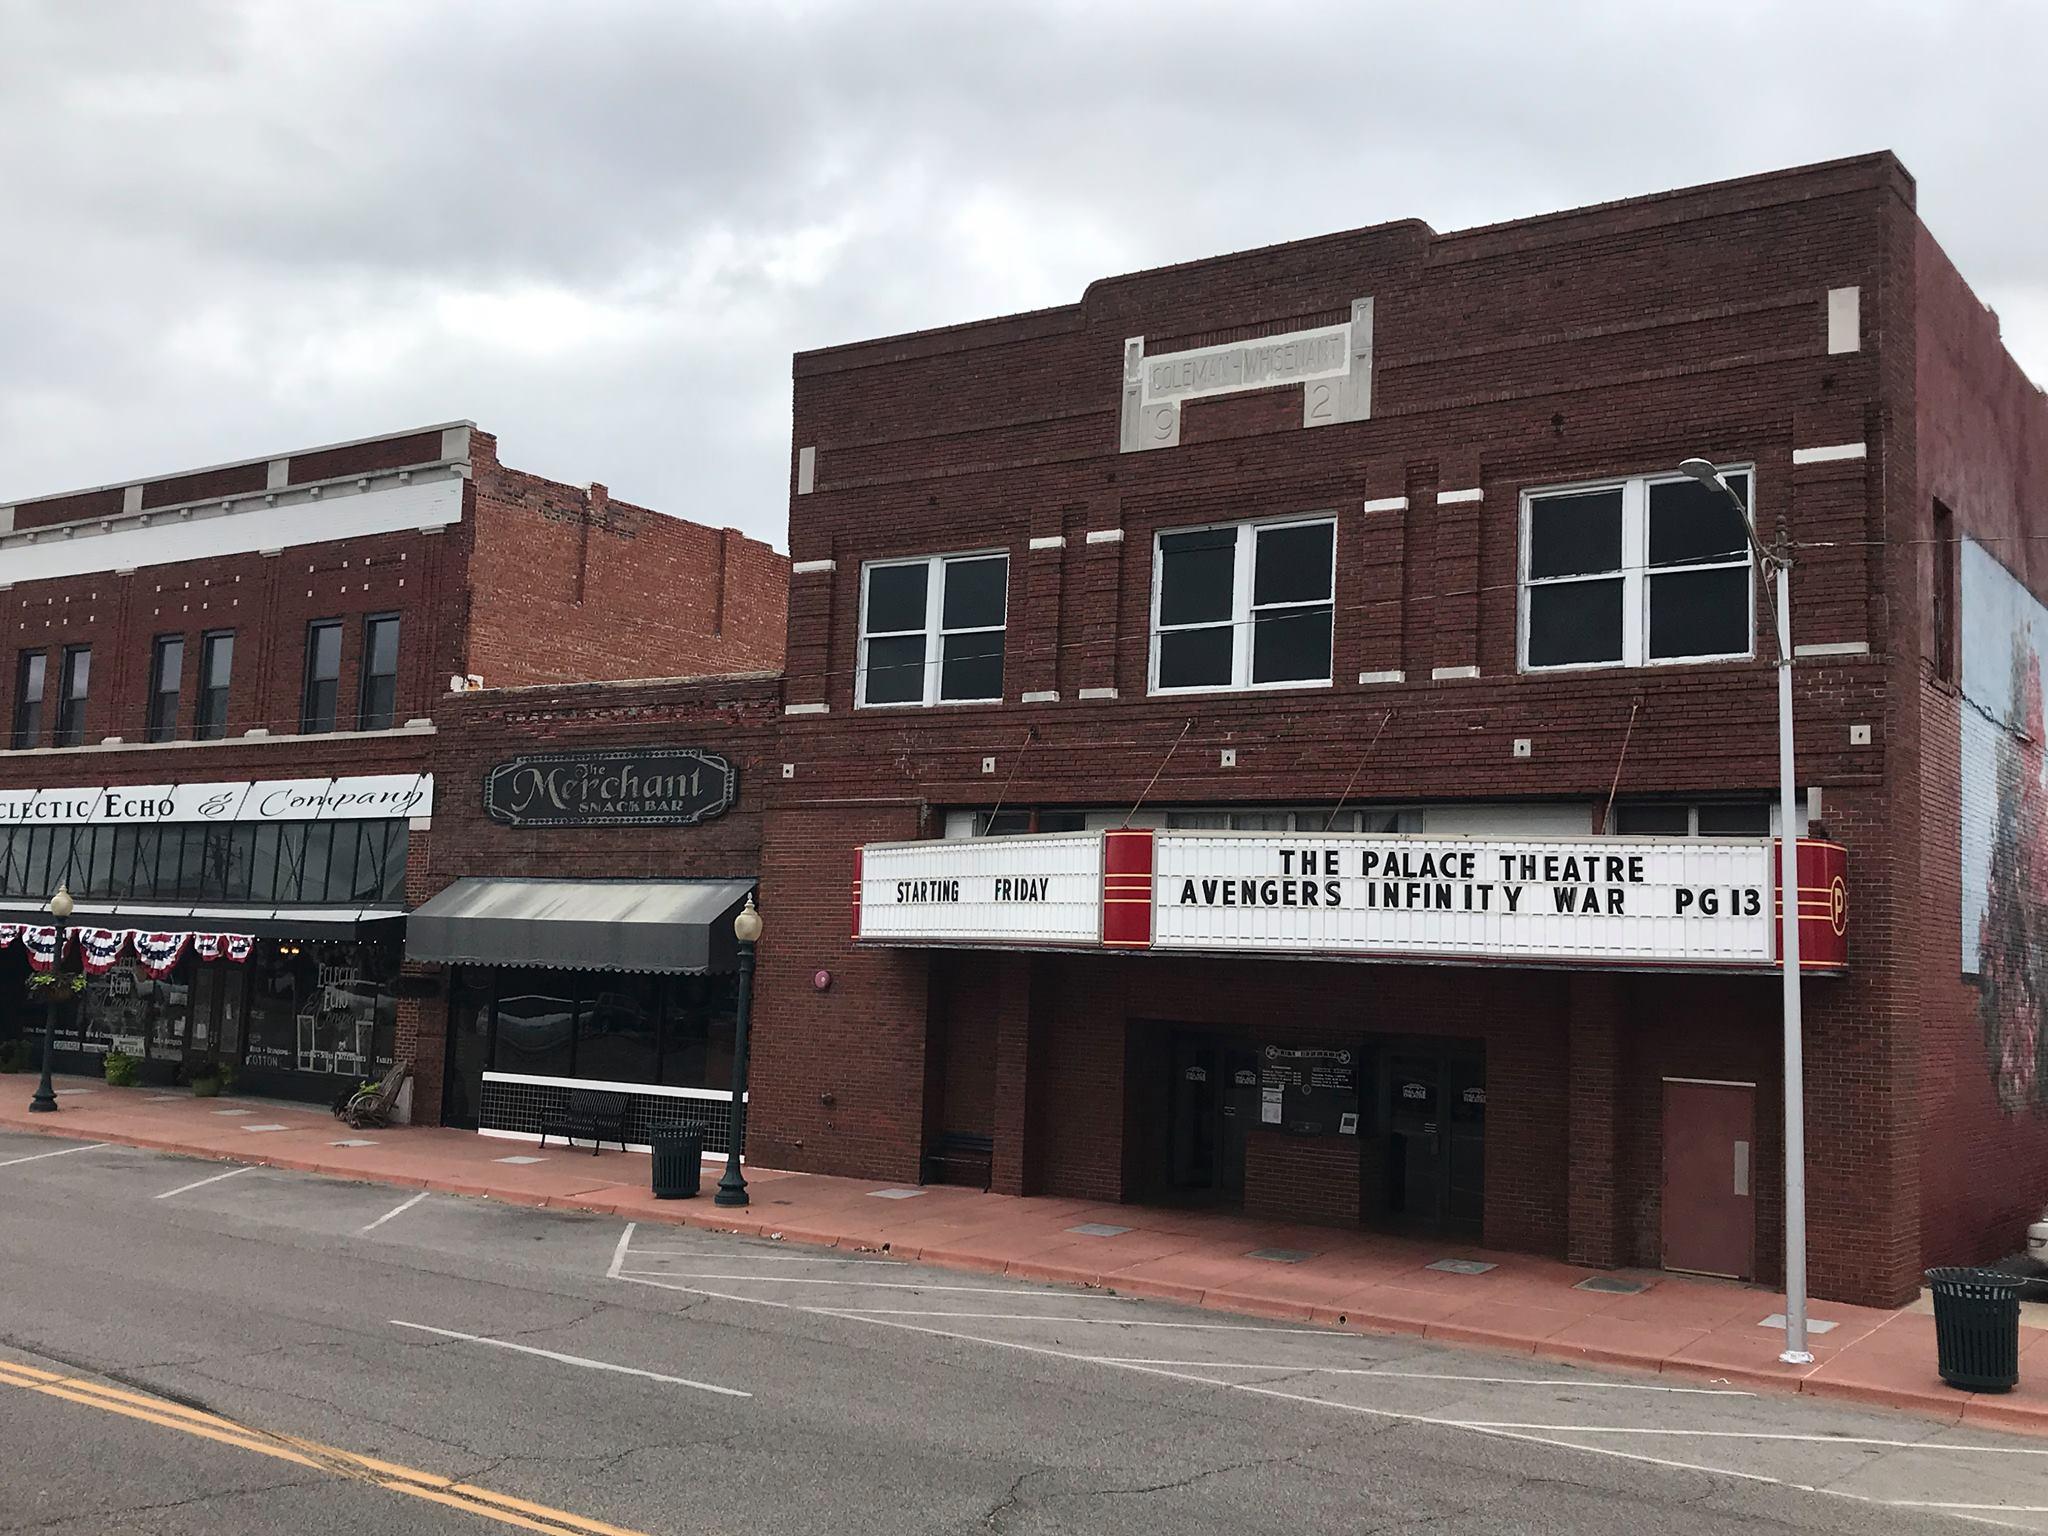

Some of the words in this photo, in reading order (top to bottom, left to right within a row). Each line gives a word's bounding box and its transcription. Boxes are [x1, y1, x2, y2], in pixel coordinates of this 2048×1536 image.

[574, 763, 606, 779] The
[104, 793, 175, 818] ECHO
[198, 791, 234, 817] &
[259, 788, 424, 817] Company
[510, 763, 704, 813] Merchant
[578, 799, 641, 813] SNACK
[644, 799, 684, 813] BAR
[1279, 849, 1340, 876] THE
[1361, 851, 1476, 878] PALACE
[1499, 854, 1645, 883] THEATRE
[896, 879, 960, 903] STARTING
[994, 877, 1050, 902] FRIDAY
[1179, 879, 1342, 907] AVENGERS
[1367, 882, 1523, 912] INFINITY
[1553, 886, 1625, 915] WAR
